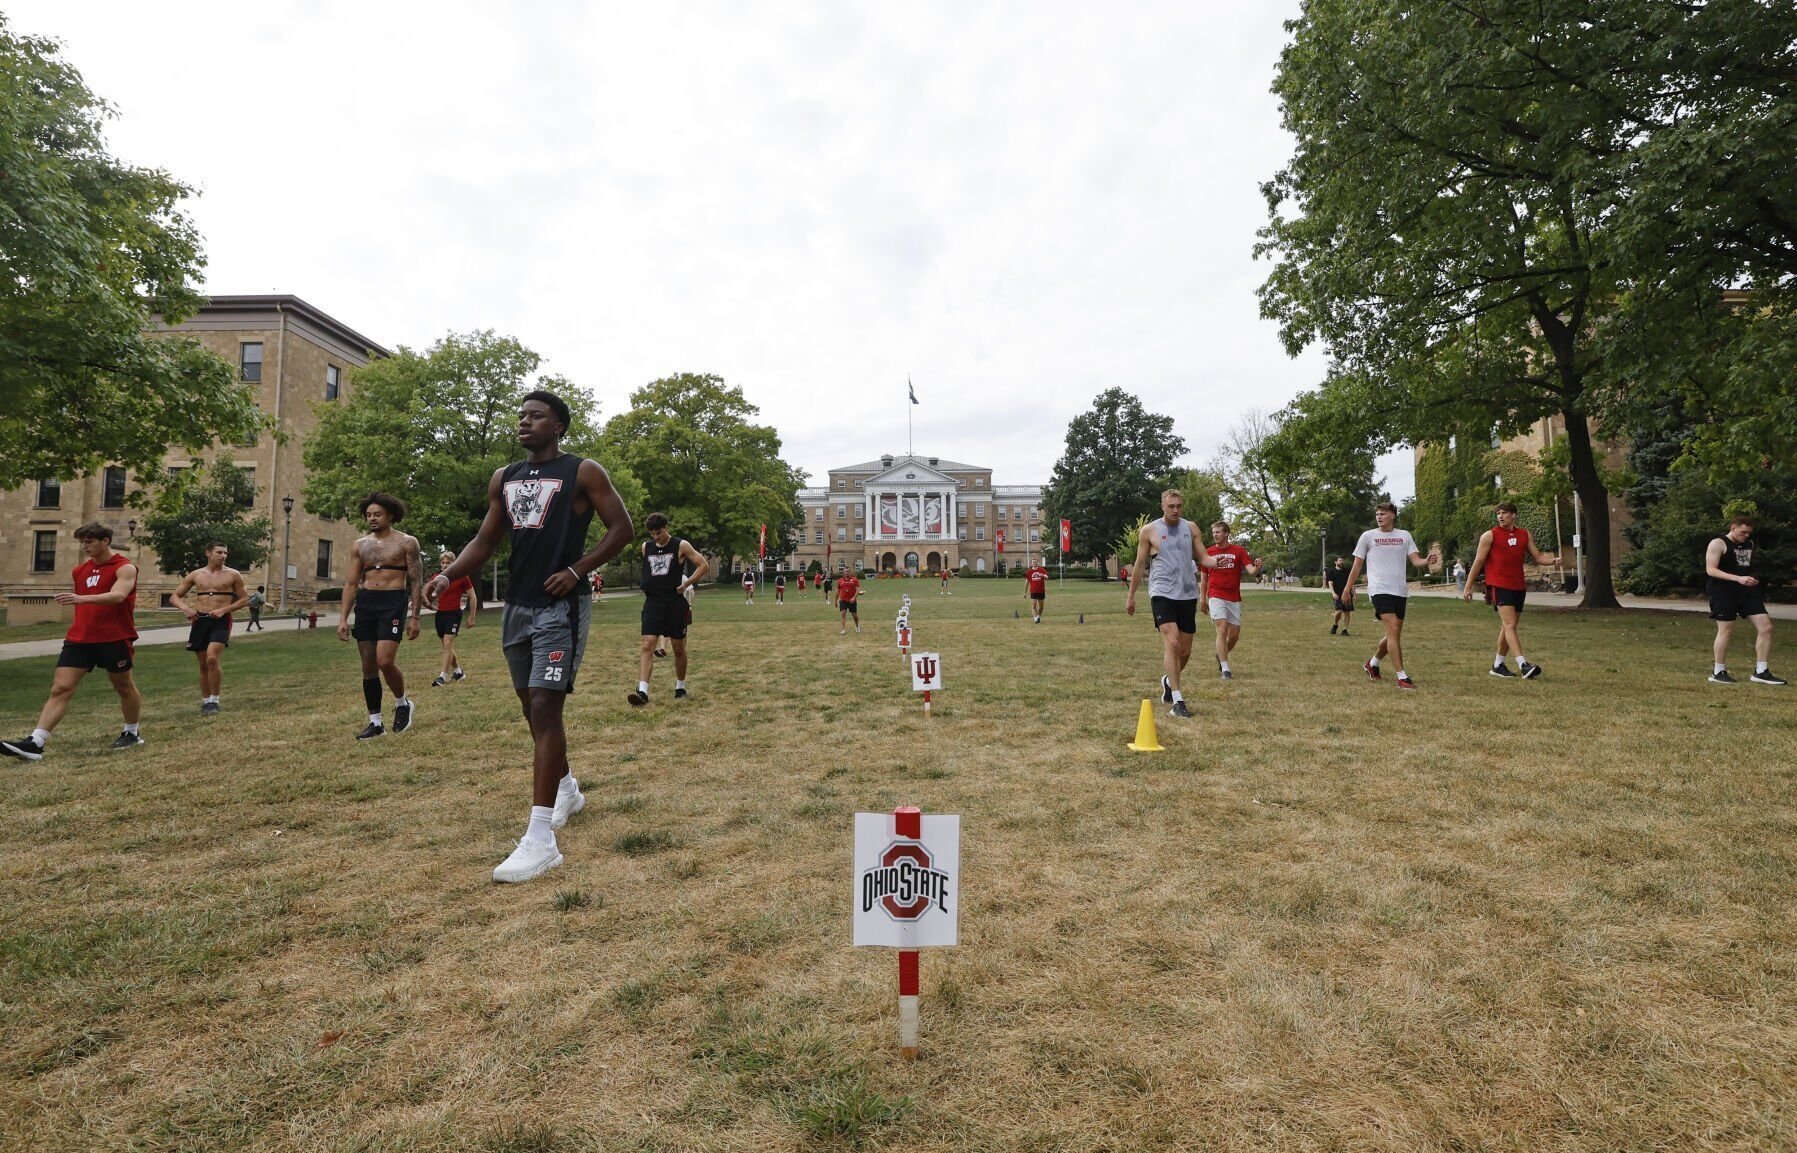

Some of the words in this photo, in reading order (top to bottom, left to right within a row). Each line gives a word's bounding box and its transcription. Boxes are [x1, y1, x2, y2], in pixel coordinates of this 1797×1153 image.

[86, 575, 100, 588] W
[548, 650, 564, 663] W
[544, 666, 563, 682] 25
[862, 867, 899, 913] OHIO
[900, 862, 949, 914] STATE
